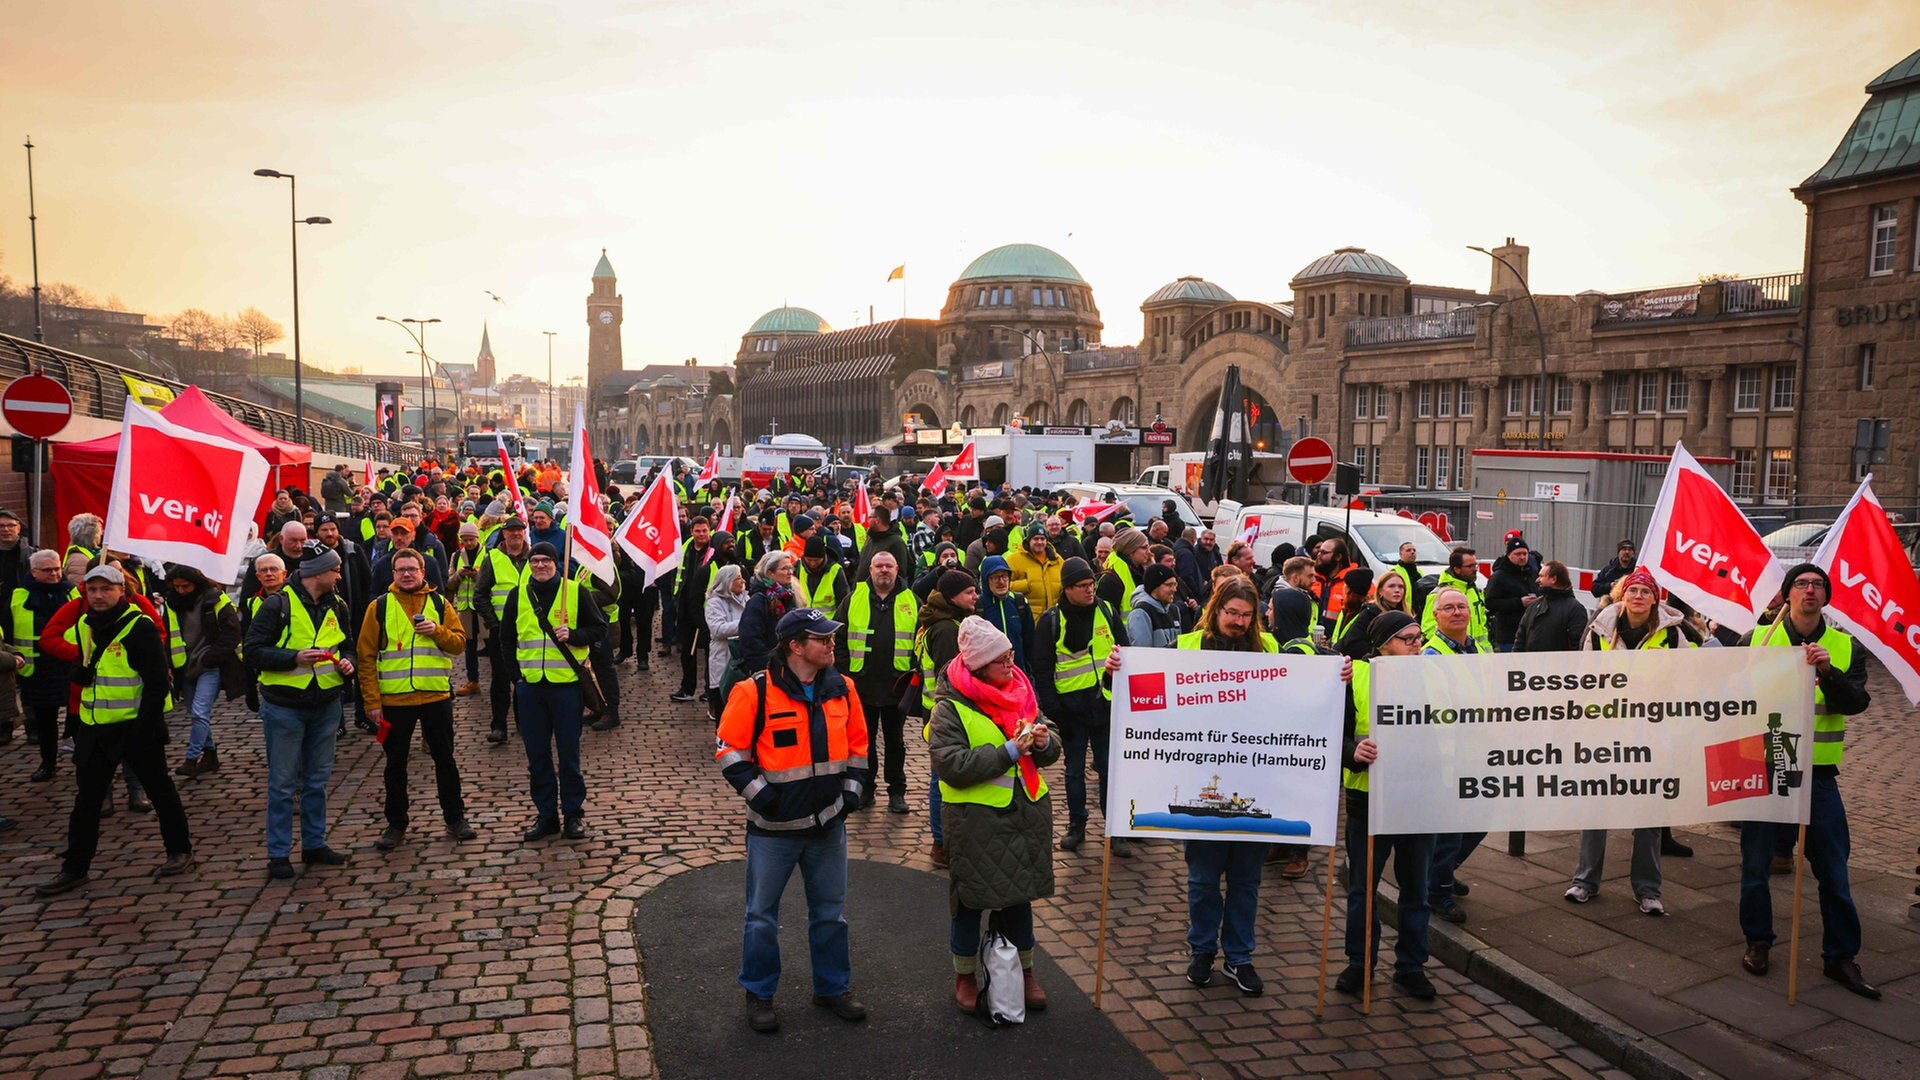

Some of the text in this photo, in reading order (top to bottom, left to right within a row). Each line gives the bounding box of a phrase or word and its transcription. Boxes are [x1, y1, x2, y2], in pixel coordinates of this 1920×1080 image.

[1537, 484, 1560, 496] TMS
[139, 493, 223, 538] ver.di
[1175, 665, 1288, 685] Betriebsgruppe
[1507, 671, 1628, 691] Bessere
[1177, 689, 1247, 706] beim BSH
[1377, 698, 1757, 725] Einkommensbedingungen
[1125, 727, 1328, 748] Bundesamt für Seeschifffahrt
[1123, 748, 1327, 770] und Hydrographie (Hamburg)
[1487, 741, 1652, 766] auch beim
[1772, 727, 1787, 787] HAMBURG
[1459, 774, 1680, 800] BSH Hamburg
[1710, 774, 1763, 792] ver.di
